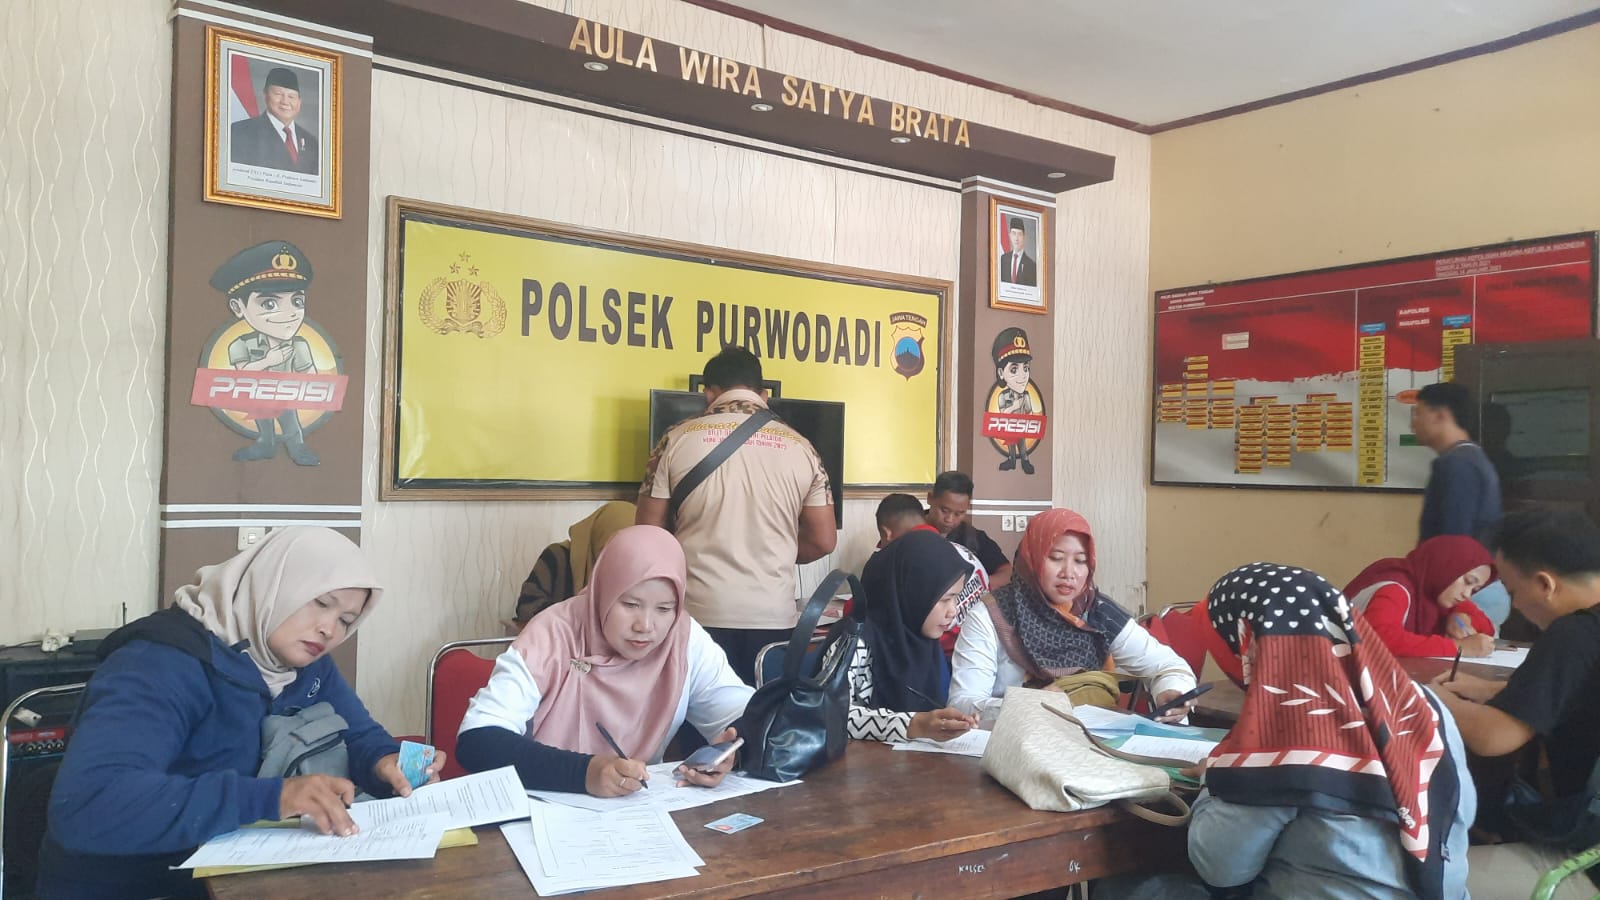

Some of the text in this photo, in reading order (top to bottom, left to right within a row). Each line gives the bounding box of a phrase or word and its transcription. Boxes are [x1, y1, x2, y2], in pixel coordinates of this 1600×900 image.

[569, 17, 971, 148] AULA WIRA SATYA BRATA
[521, 278, 881, 368] POLSEK PURWODADI
[209, 376, 336, 403] PRESISI
[988, 417, 1041, 434] PRESISI
